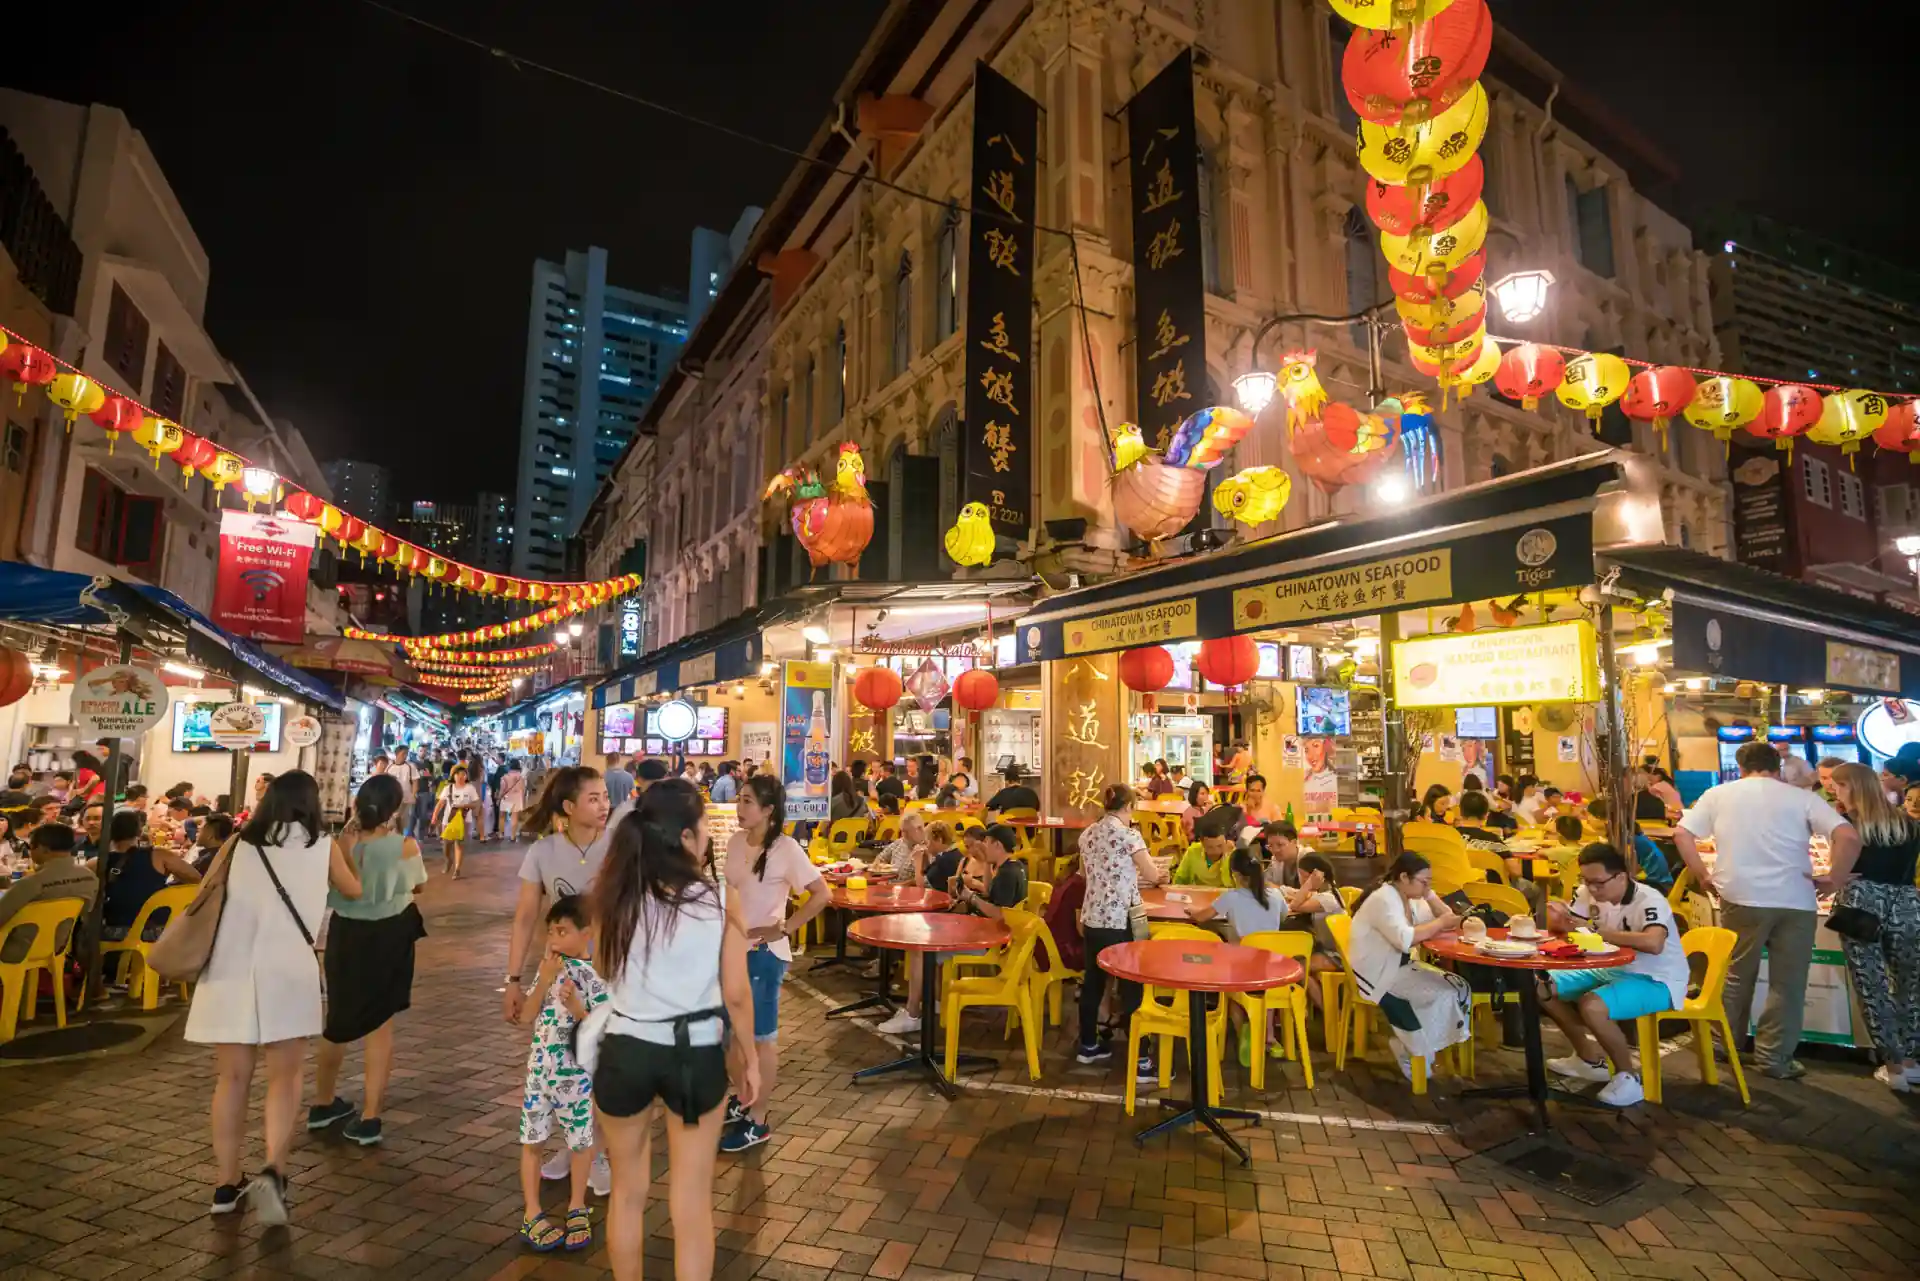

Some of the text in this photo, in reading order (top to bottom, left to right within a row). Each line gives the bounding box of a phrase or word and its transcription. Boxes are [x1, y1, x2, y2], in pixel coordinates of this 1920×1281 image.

[236, 541, 297, 558] Free Wi-Fi
[1275, 555, 1441, 599] CHINATOWN SEAFOOD
[1515, 568, 1555, 587] Tiger
[1299, 580, 1406, 613] 八道馆鱼虾蟹
[1091, 603, 1191, 632] CHINATOWN SEAFOOD
[122, 700, 156, 716] ALE
[90, 715, 144, 724] ARCHIPELAGO
[98, 723, 137, 731] BREWERY
[1644, 907, 1658, 922] 5
